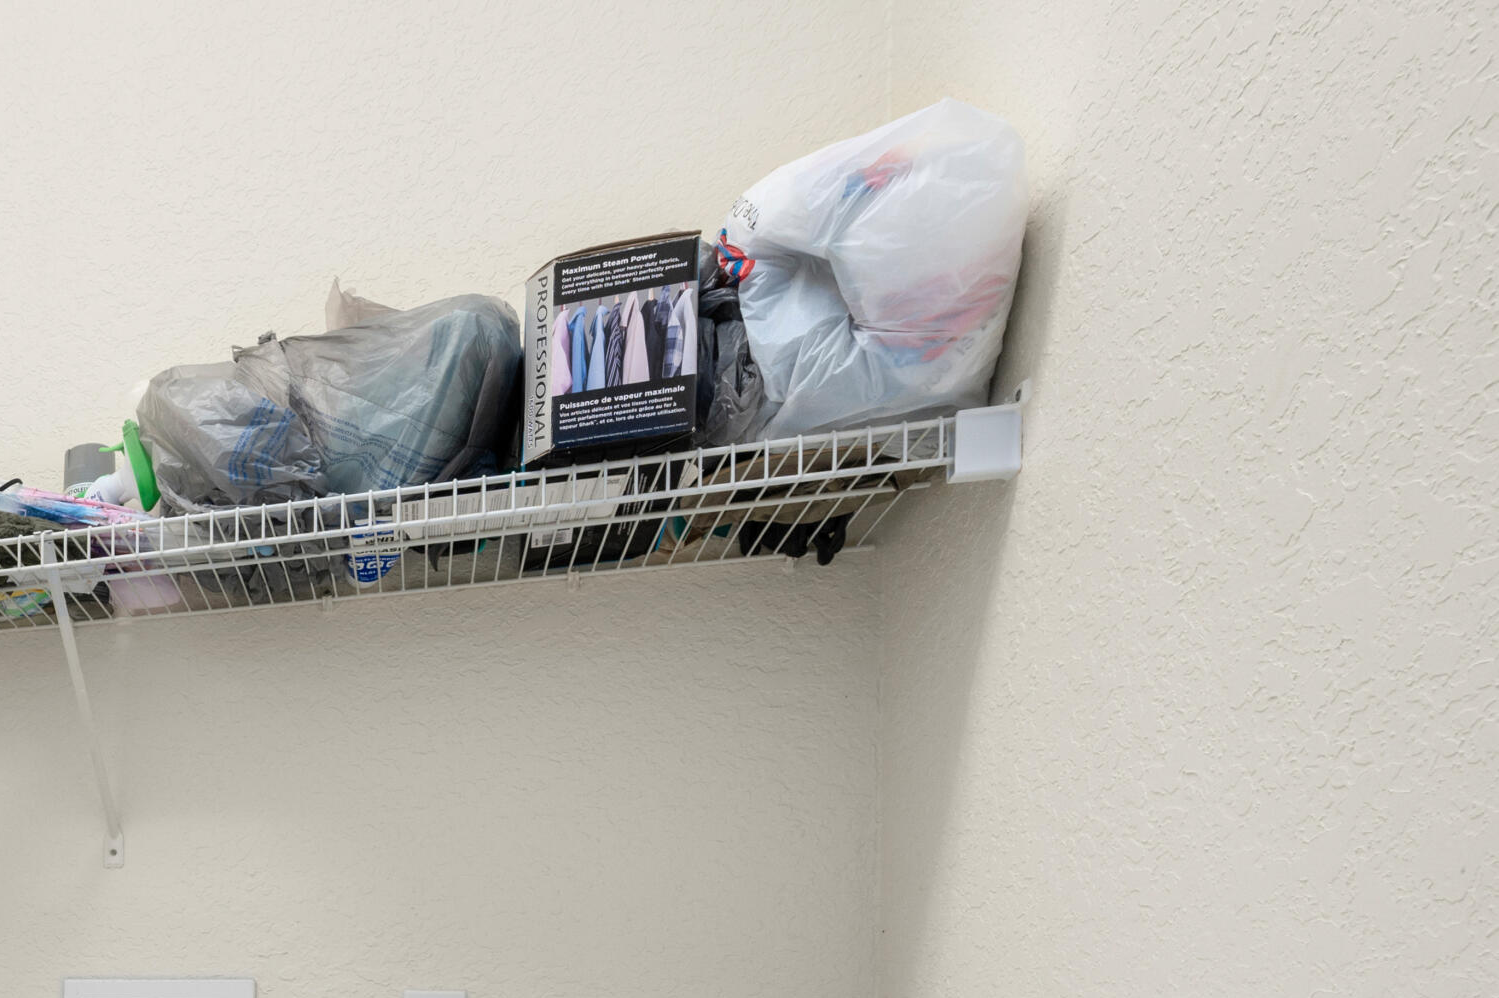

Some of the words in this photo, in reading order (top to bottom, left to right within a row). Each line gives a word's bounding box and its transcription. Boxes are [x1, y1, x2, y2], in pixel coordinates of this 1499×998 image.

[562, 263, 600, 275] Maximum
[603, 259, 629, 268] Steam
[631, 252, 657, 262] Power
[575, 278, 604, 288] everything
[639, 266, 664, 275] perfectly
[665, 261, 688, 270] pressed
[535, 276, 548, 448] PROFESSIONAL
[560, 399, 599, 409] Puissance
[614, 391, 643, 402] vapeur
[644, 385, 685, 397] maximale
[636, 411, 656, 419] chaque
